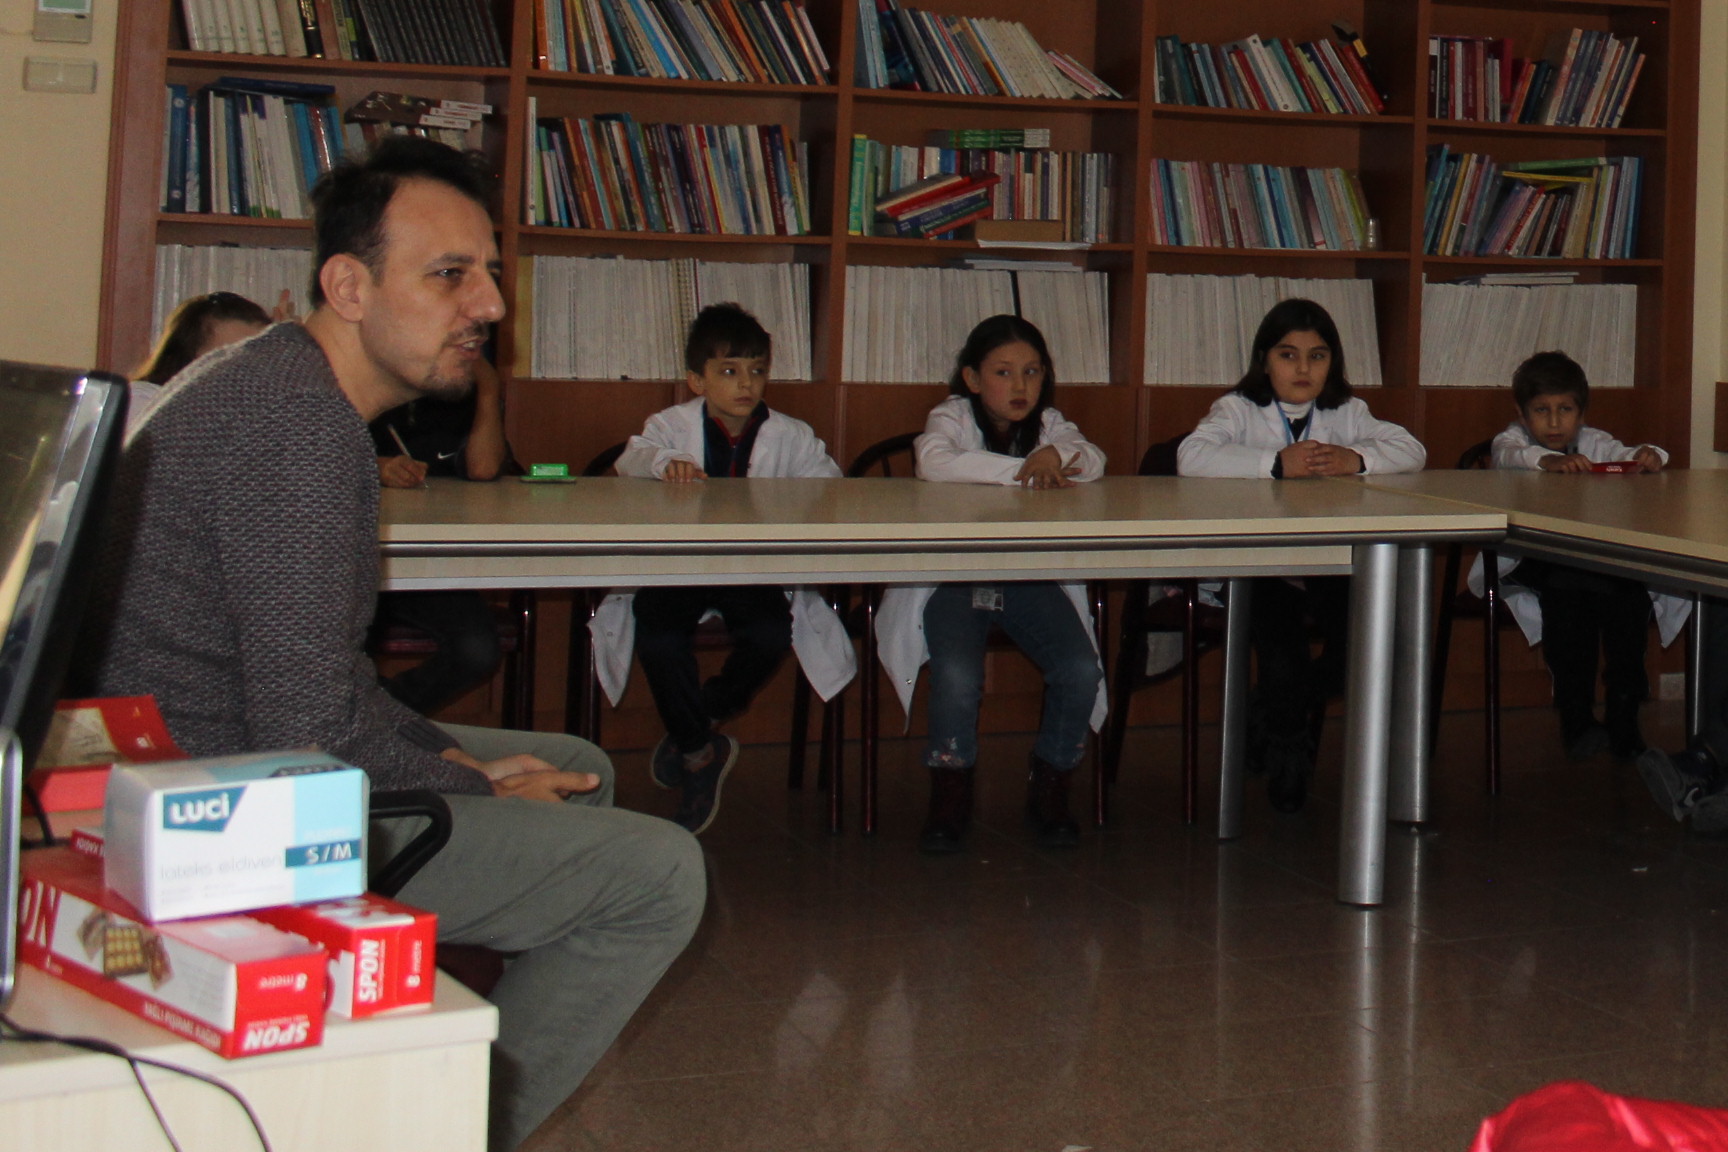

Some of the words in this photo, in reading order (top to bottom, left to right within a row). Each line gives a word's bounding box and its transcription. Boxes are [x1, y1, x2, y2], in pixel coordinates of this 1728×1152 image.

[160, 858, 214, 881] lateks
[218, 854, 283, 873] eldiven
[258, 974, 295, 990] metre
[294, 972, 309, 992] 8
[358, 939, 380, 1004] SPON
[406, 973, 421, 989] 8
[242, 1020, 312, 1052] SPON
